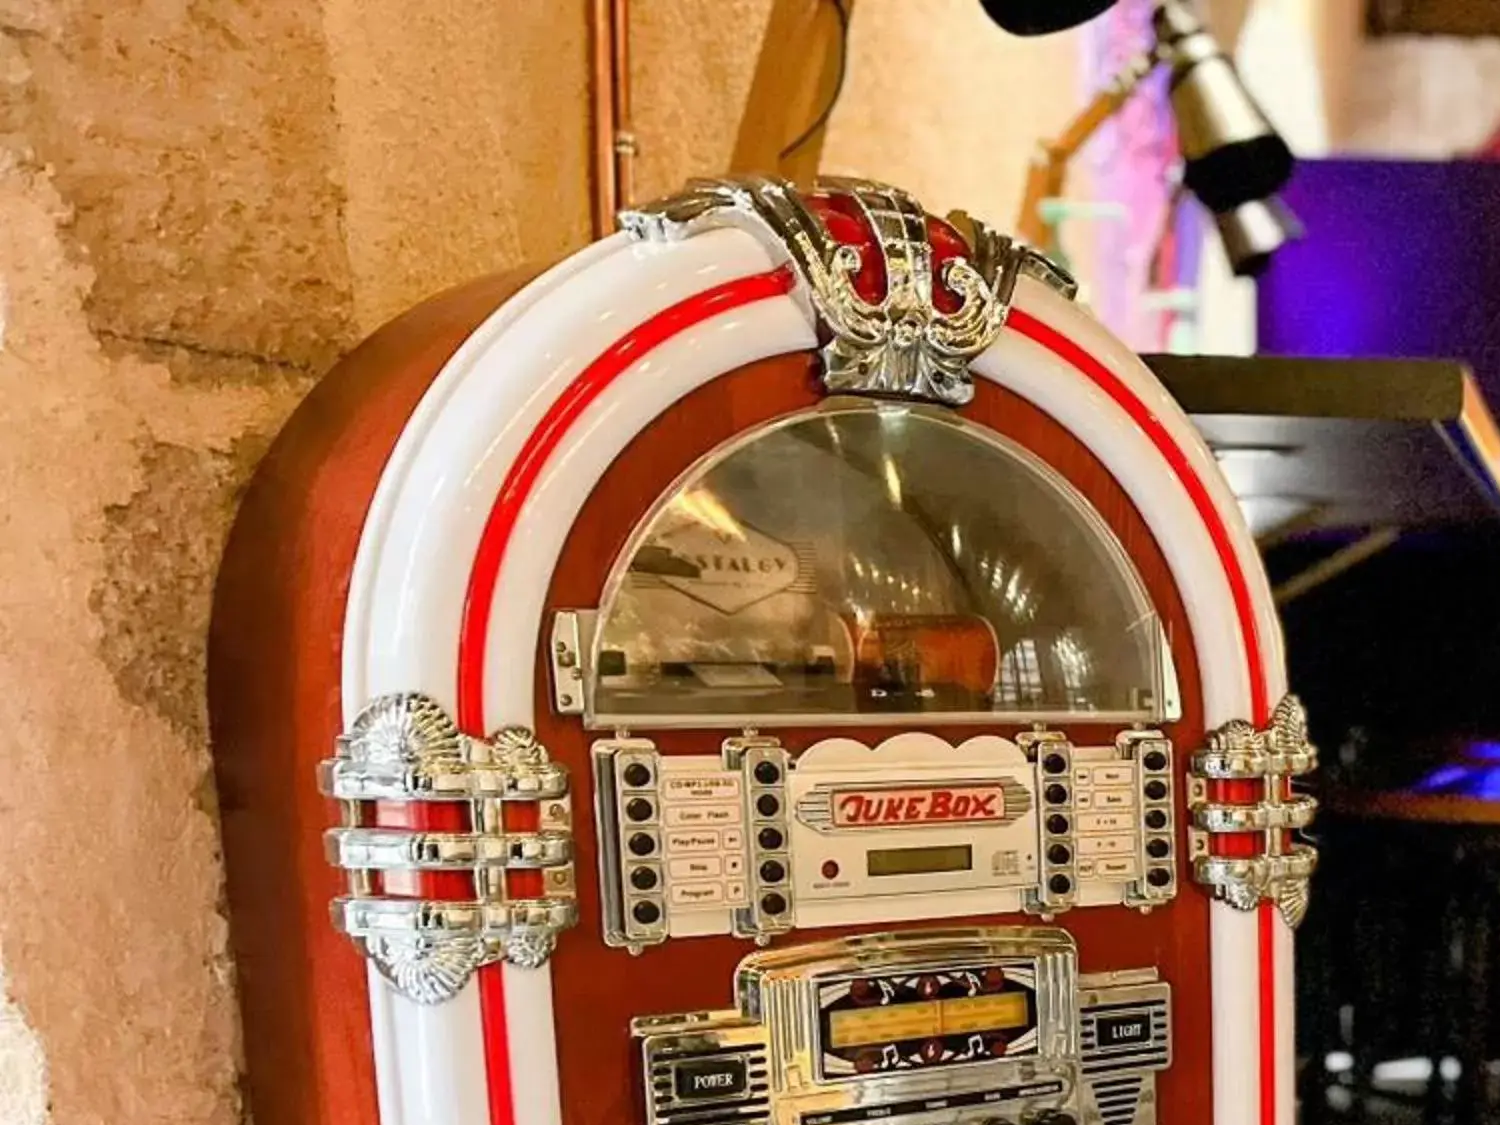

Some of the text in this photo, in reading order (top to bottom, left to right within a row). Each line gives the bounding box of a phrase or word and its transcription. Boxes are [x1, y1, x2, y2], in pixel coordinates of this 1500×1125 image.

[683, 553, 786, 574] STALGY
[1111, 1023, 1142, 1039] LIGHT
[693, 1072, 734, 1089] POWER
